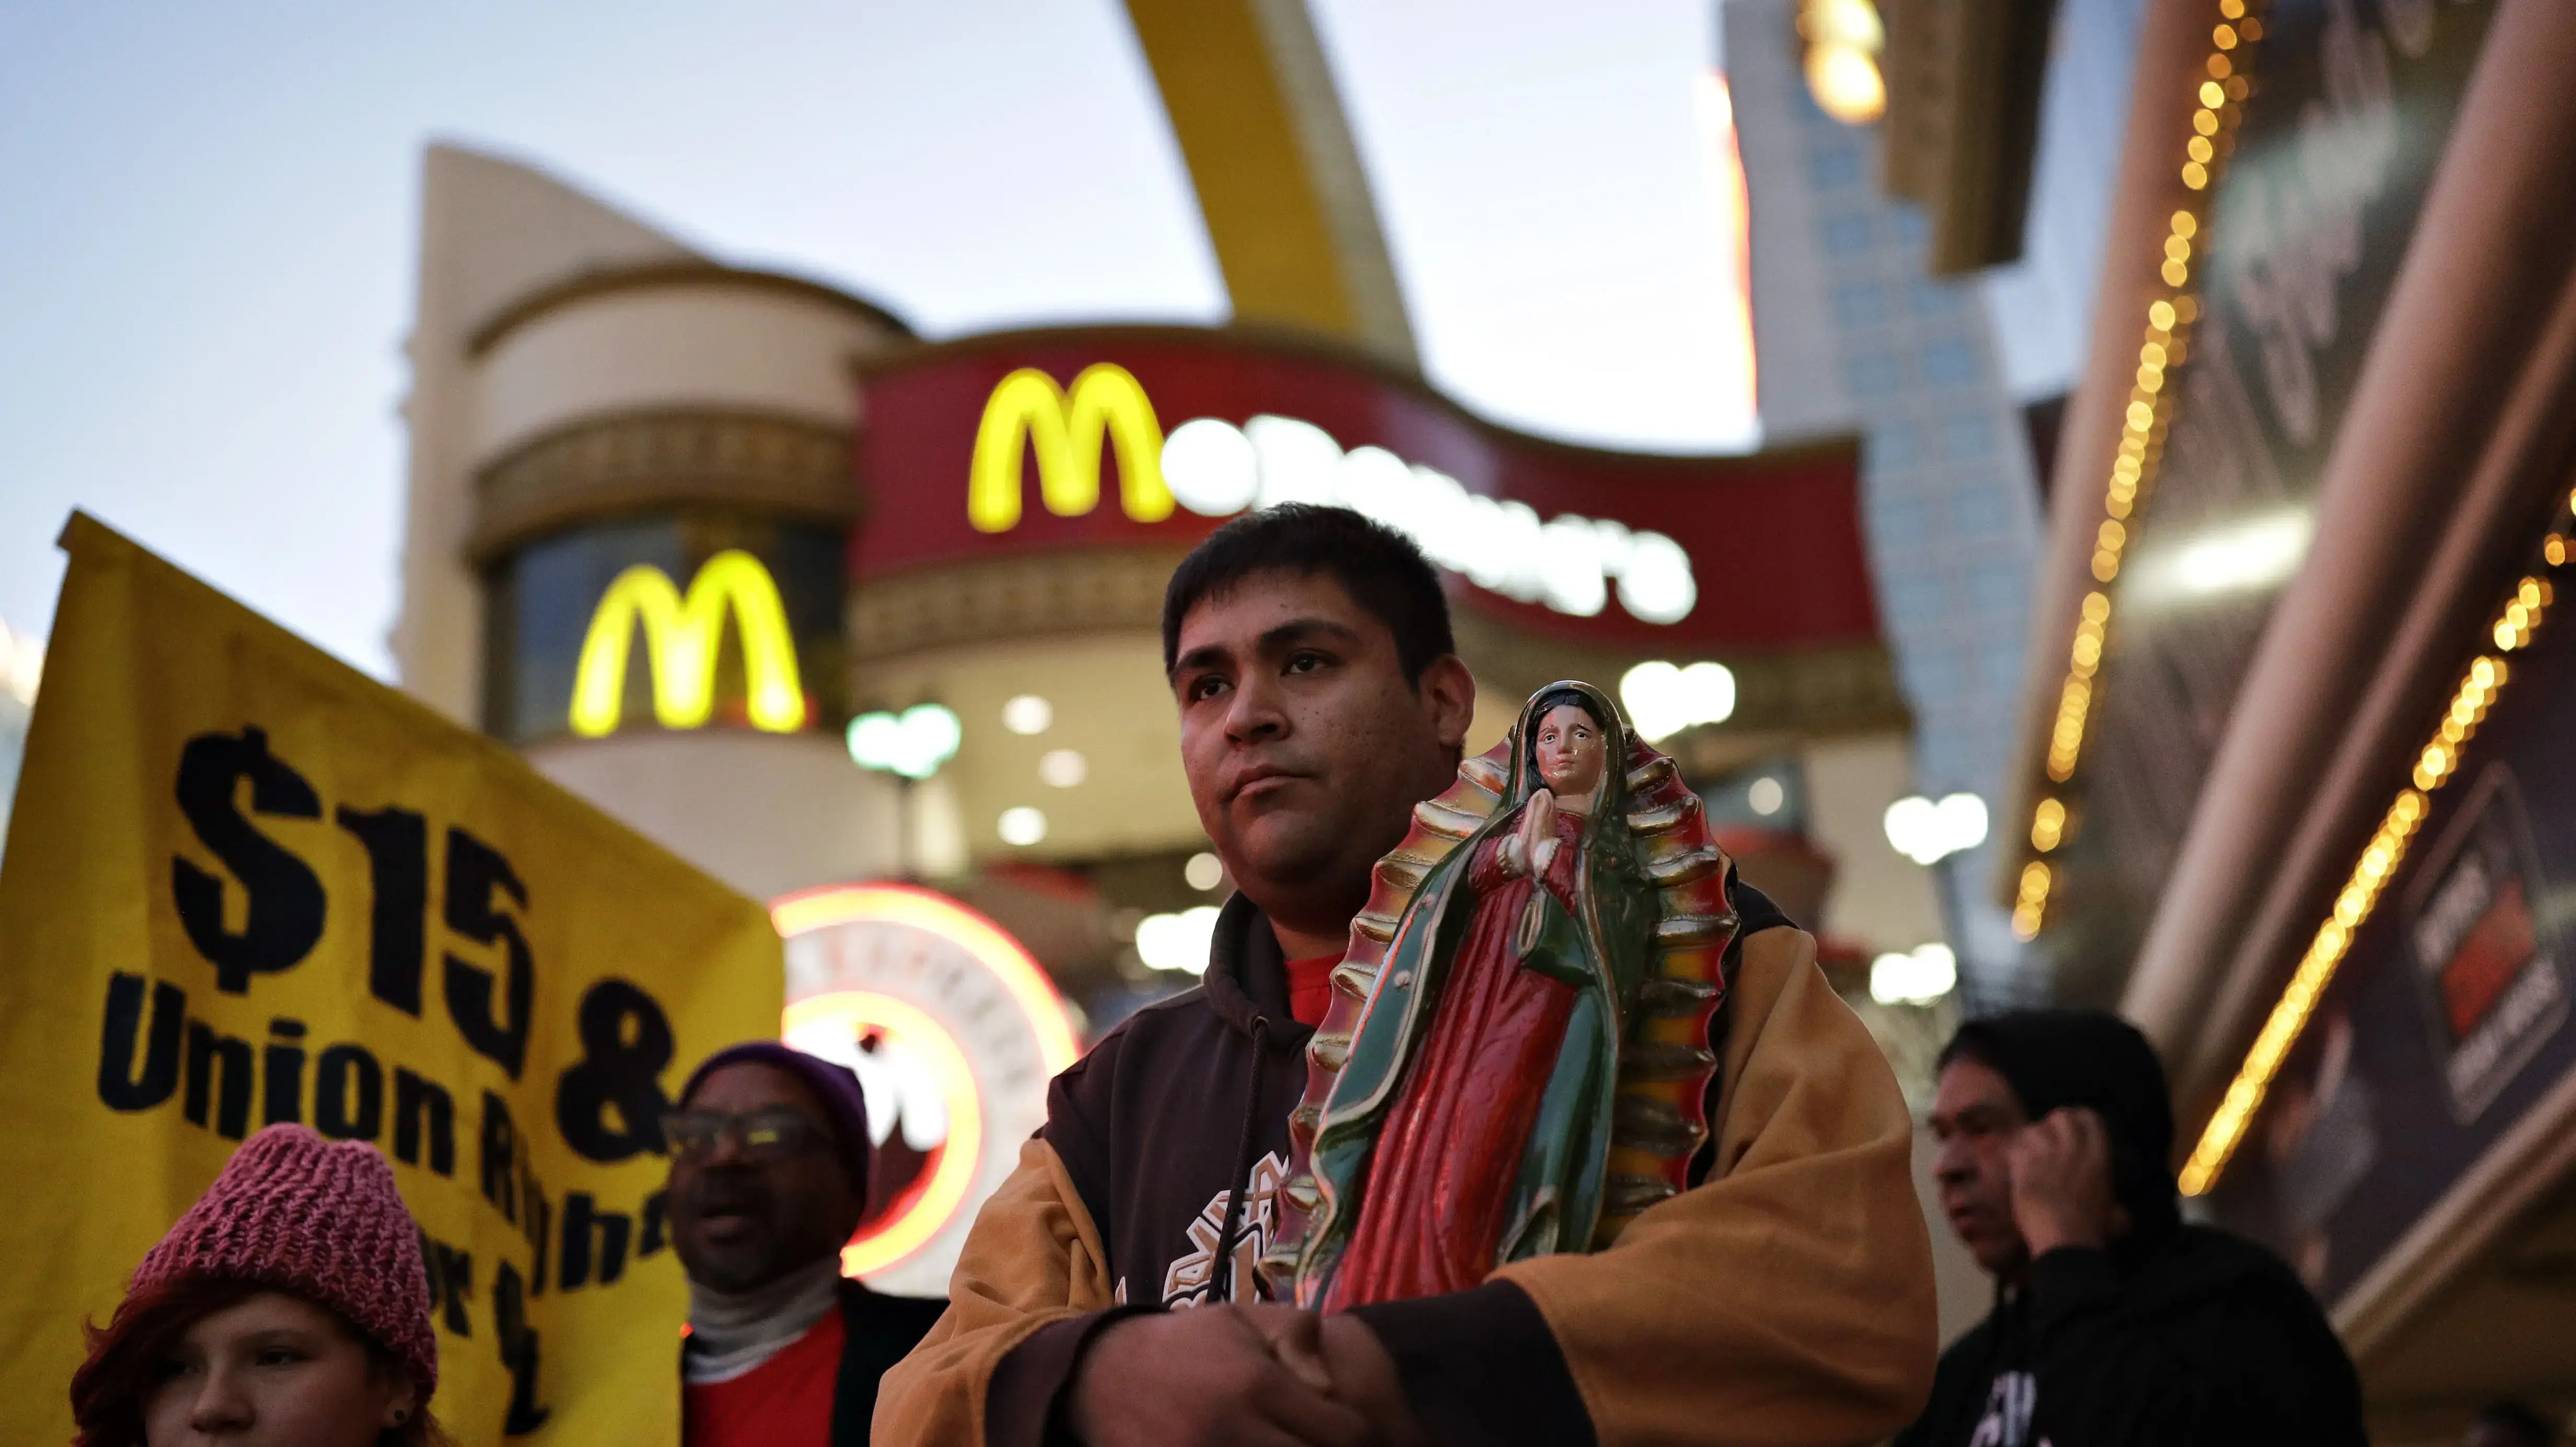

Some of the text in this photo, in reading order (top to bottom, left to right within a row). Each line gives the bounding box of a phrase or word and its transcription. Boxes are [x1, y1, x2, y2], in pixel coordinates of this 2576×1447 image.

[98, 971, 455, 1177] Union
[172, 724, 534, 1081] $15
[555, 977, 672, 1163] &
